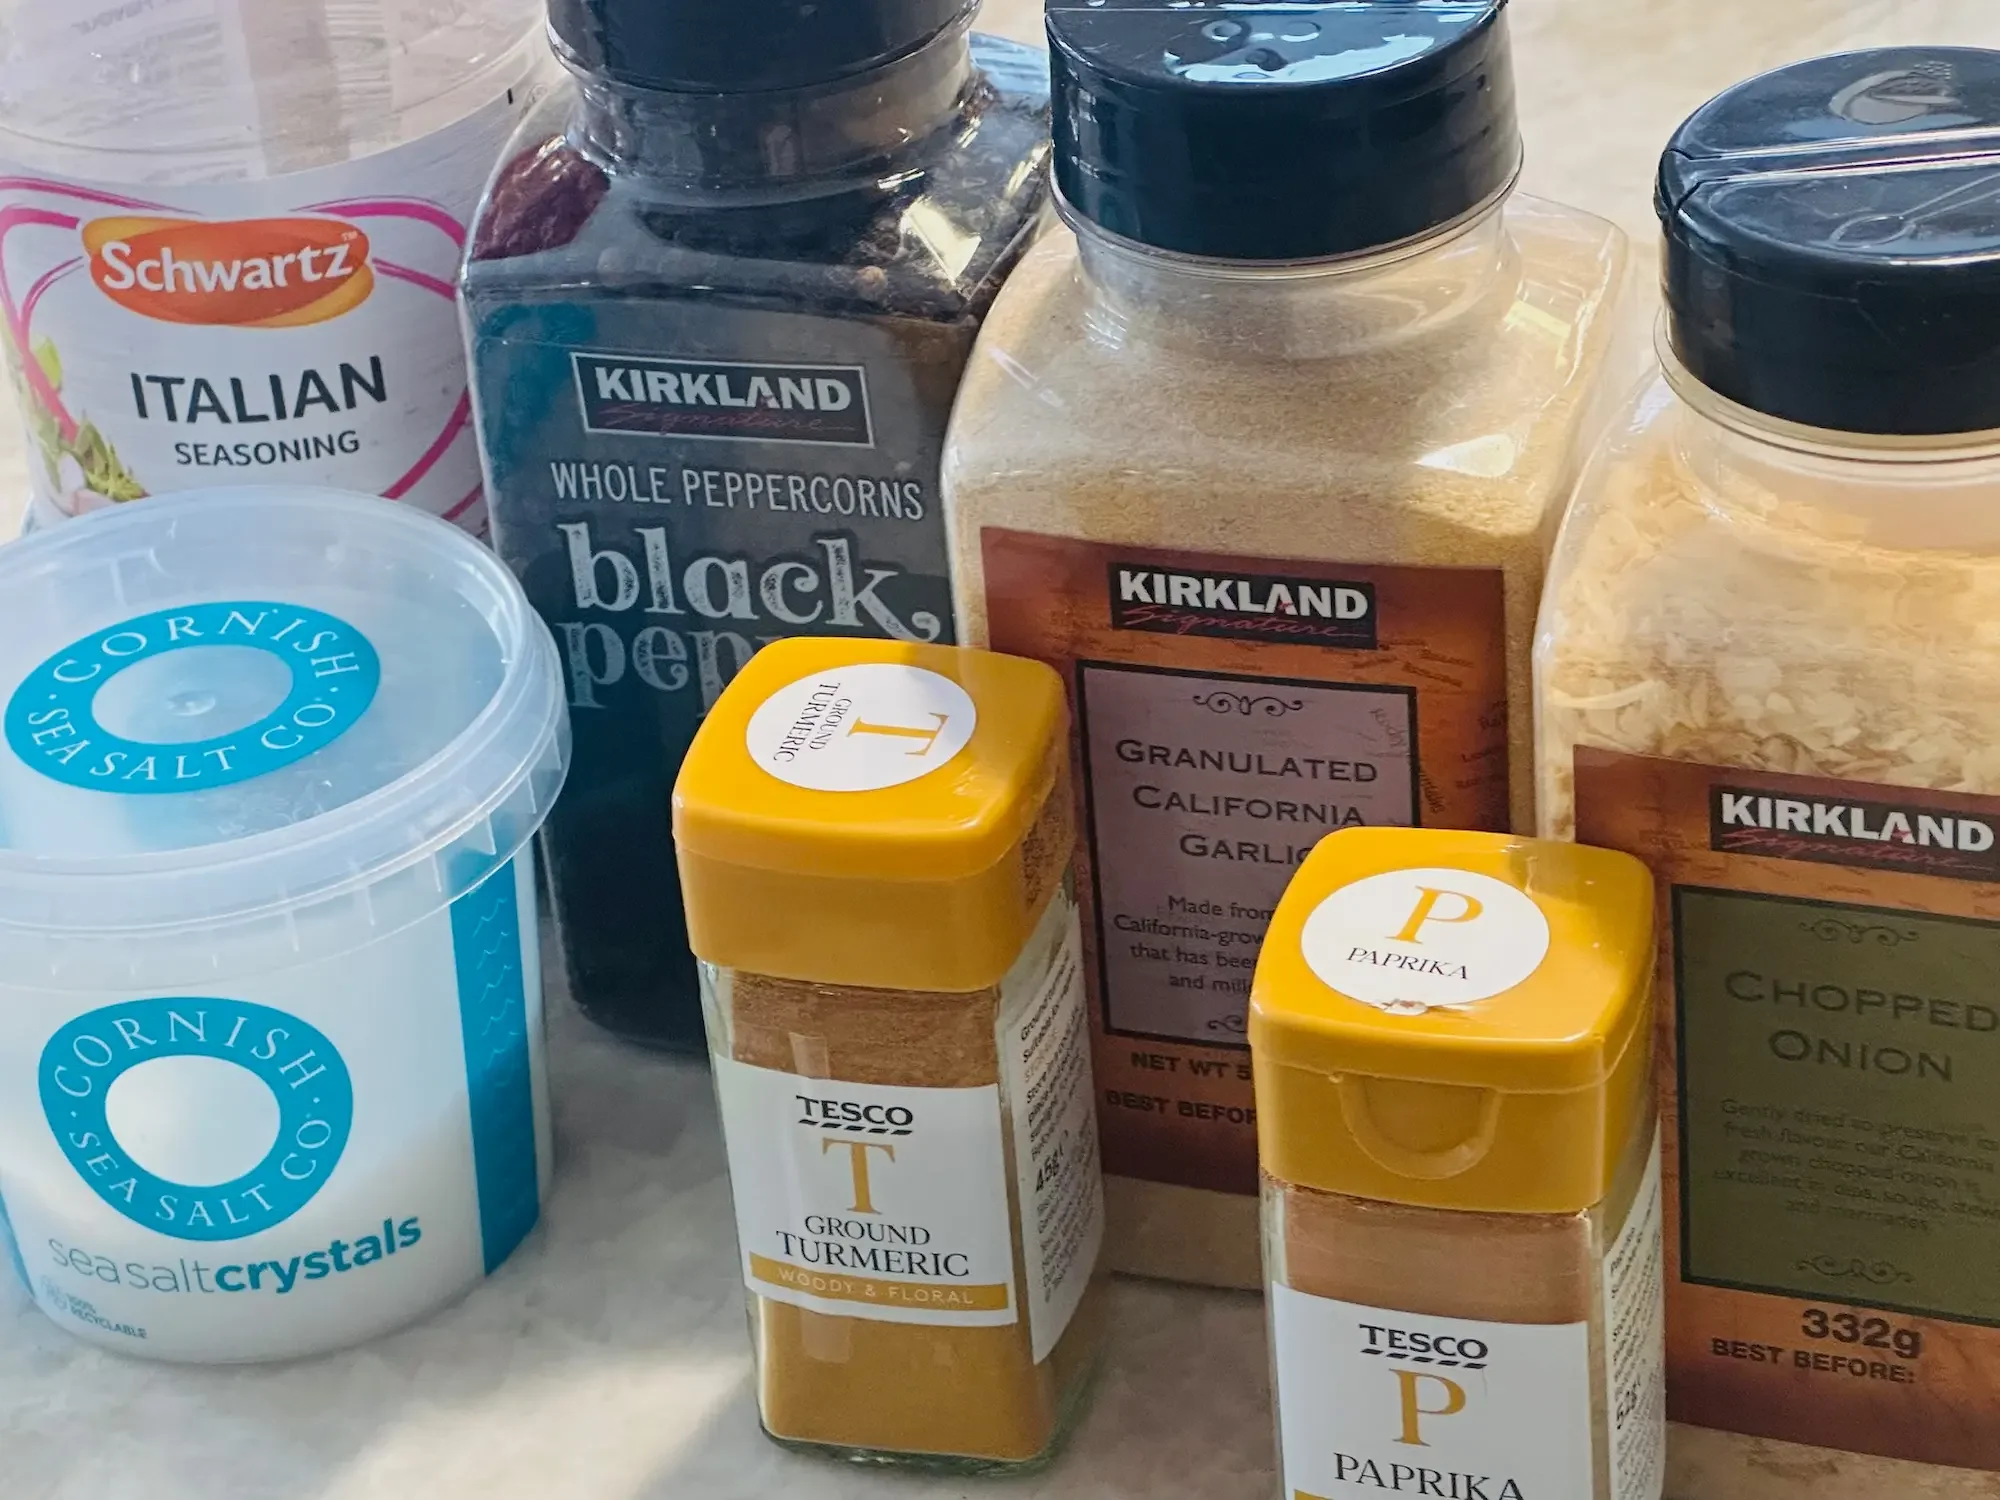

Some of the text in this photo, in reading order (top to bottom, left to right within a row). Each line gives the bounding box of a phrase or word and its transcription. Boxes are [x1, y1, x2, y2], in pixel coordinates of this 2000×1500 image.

[104, 241, 353, 293] Schwartz
[131, 355, 387, 424] ITALIAN
[595, 367, 851, 412] KIRKLAND
[599, 402, 855, 436] Signature
[175, 431, 360, 465] SEASONING
[551, 462, 924, 521] WHOLE PEPPERCORNS
[557, 521, 941, 643] black
[1119, 569, 1369, 621] KIRKLAND
[1121, 603, 1370, 638] Signature
[53, 610, 360, 683] CORNISH
[555, 621, 782, 719] pep
[28, 708, 91, 766] SEA
[90, 745, 237, 780] SALT
[773, 682, 841, 763] TURMERIC
[808, 698, 852, 750] GROUND
[847, 712, 949, 756] T
[1115, 738, 1377, 783] GRANULATED
[1133, 785, 1365, 826] CALIFORNIA
[1721, 792, 1994, 852] KIRKLAND
[1168, 895, 1223, 914] Made
[1385, 886, 1484, 944] P
[1113, 914, 1263, 946] California-grow
[1131, 943, 1255, 969] that has bee
[1346, 947, 1470, 980] PAPRIKA
[1169, 974, 1204, 990] and
[1724, 969, 1999, 1031] CHOPPED
[54, 1010, 326, 1098] CORNISH
[1131, 1052, 1252, 1081] NET WT 5
[1768, 1029, 1953, 1082] ONION
[796, 1095, 913, 1127] TESCO
[1104, 1088, 1169, 1114] BEST
[70, 1131, 138, 1203] SEA
[156, 1184, 273, 1226] SALT
[822, 1137, 896, 1215] T
[776, 1230, 970, 1277] TURMERIC
[804, 1215, 931, 1245] GROUND
[777, 1266, 975, 1305] WOODY & FLORAL
[1358, 1324, 1488, 1360] TESCO
[1801, 1308, 1924, 1359] 332g
[1711, 1336, 1915, 1384] BEST BEFORE:
[1389, 1368, 1467, 1448] P
[1333, 1452, 1526, 1500] PAPRIKA
